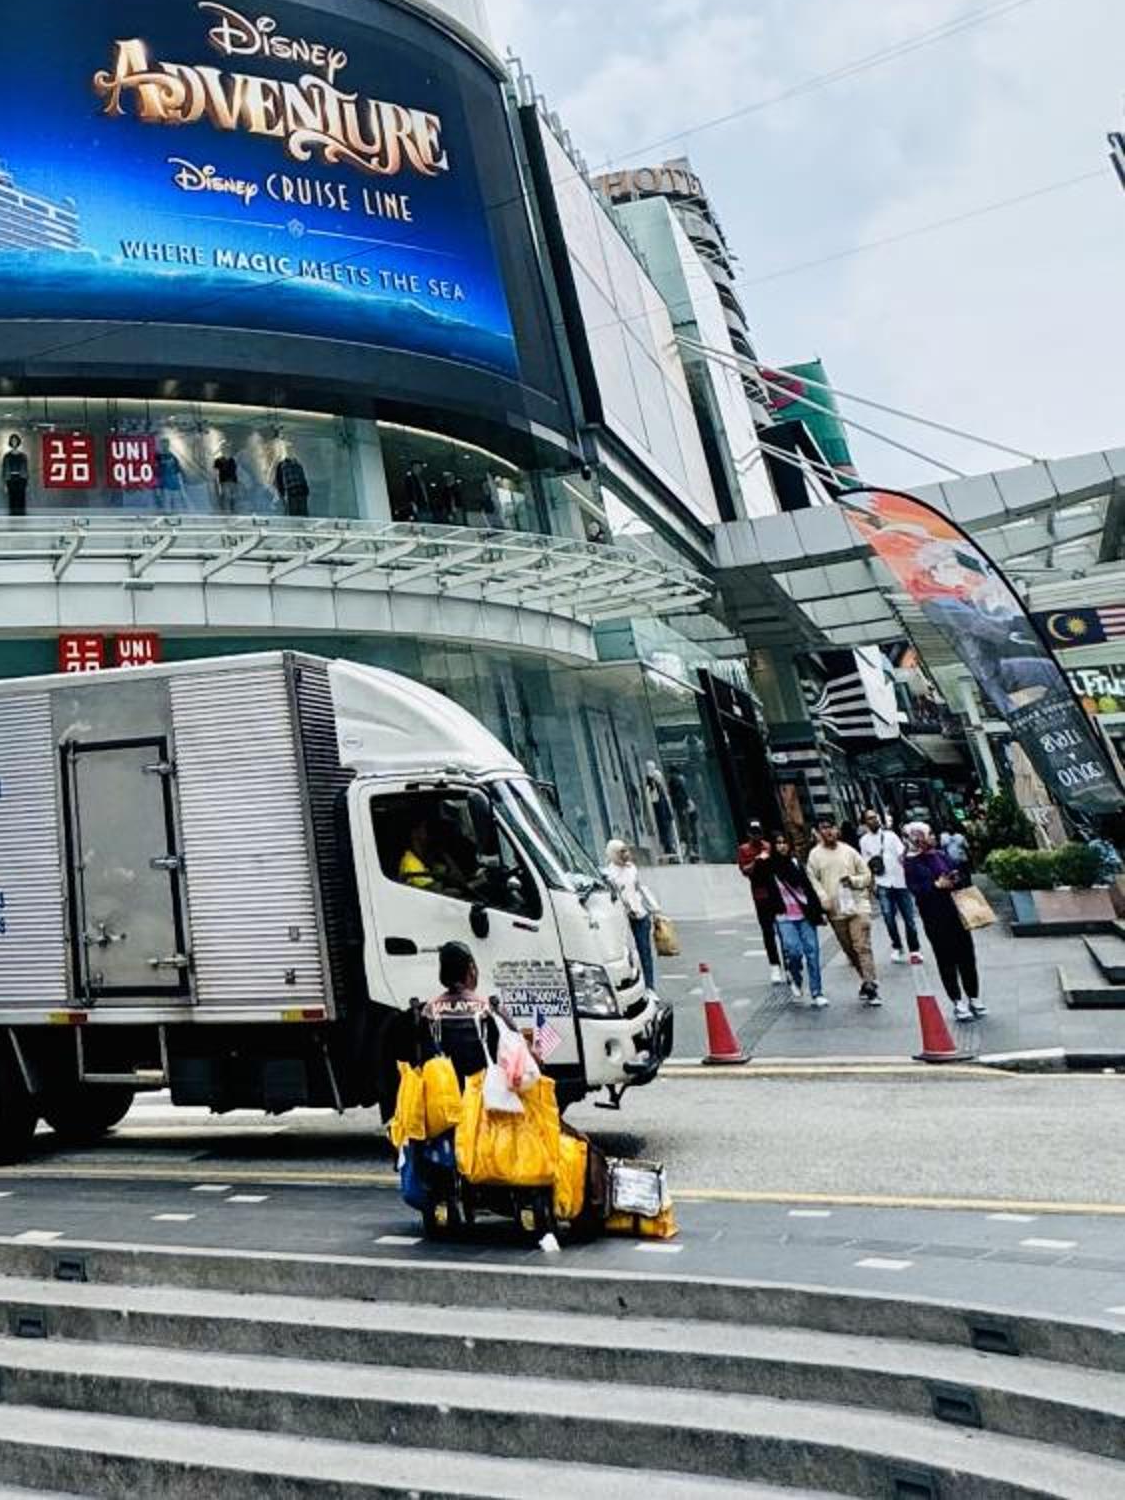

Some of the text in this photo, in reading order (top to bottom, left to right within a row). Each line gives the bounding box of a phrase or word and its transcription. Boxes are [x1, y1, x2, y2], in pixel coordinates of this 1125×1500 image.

[266, 172, 352, 212] CRUISE
[362, 186, 414, 223] LINE
[120, 238, 466, 301] WHERE MAGIC MEETS THE SEA
[111, 440, 149, 461] UNI
[113, 462, 154, 486] QLO
[118, 639, 153, 658] UNI
